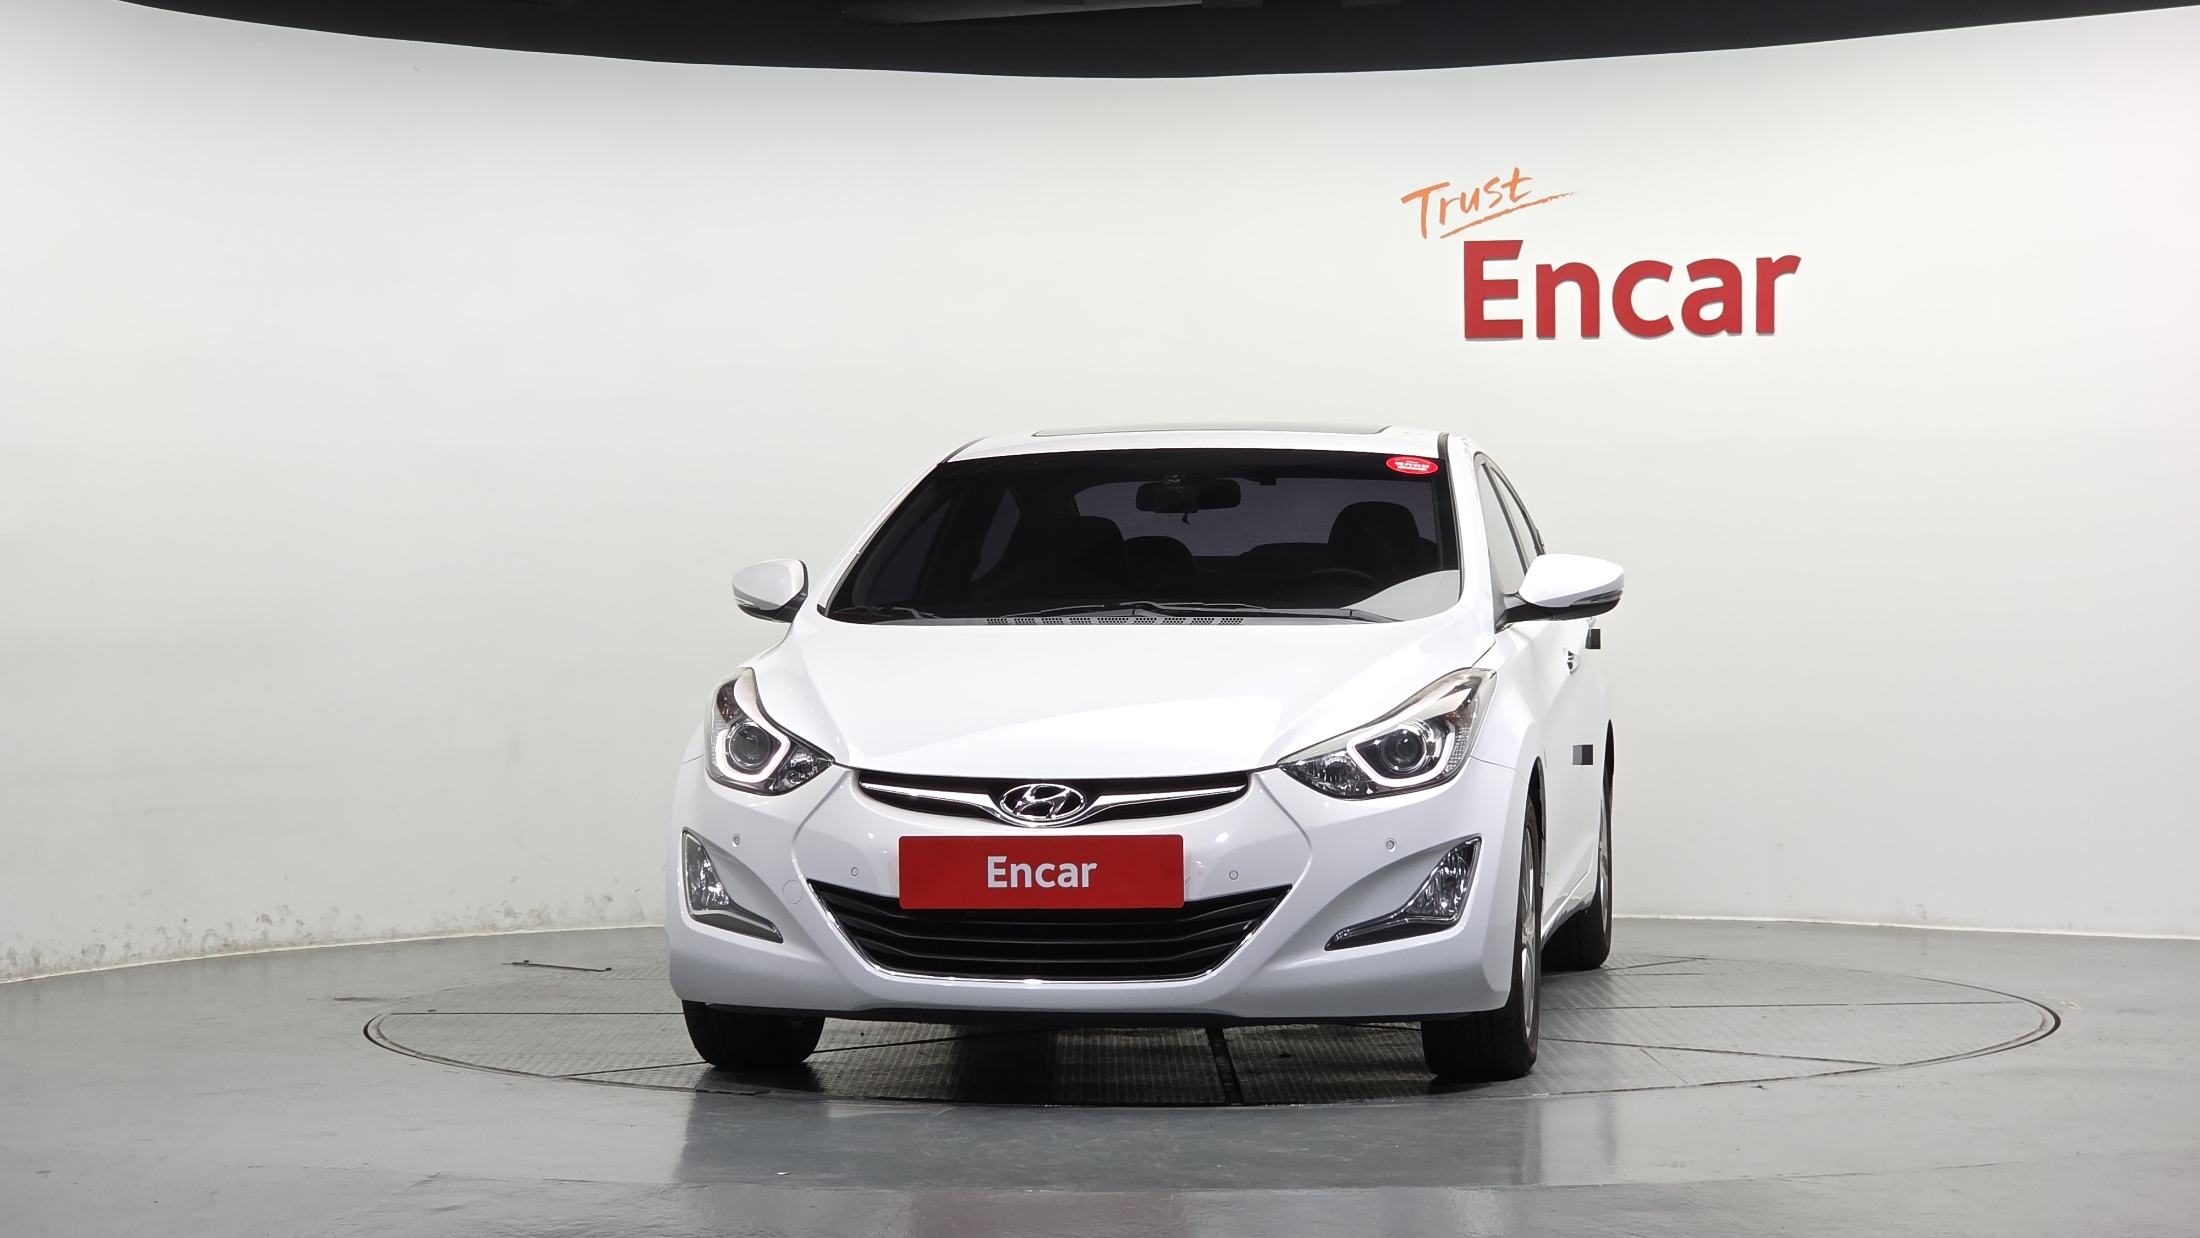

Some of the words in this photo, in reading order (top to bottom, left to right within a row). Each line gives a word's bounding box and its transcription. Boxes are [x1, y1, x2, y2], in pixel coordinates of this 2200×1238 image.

[1400, 167, 1533, 239] Trust
[1463, 239, 1802, 339] Encar
[987, 855, 1098, 888] Encar
